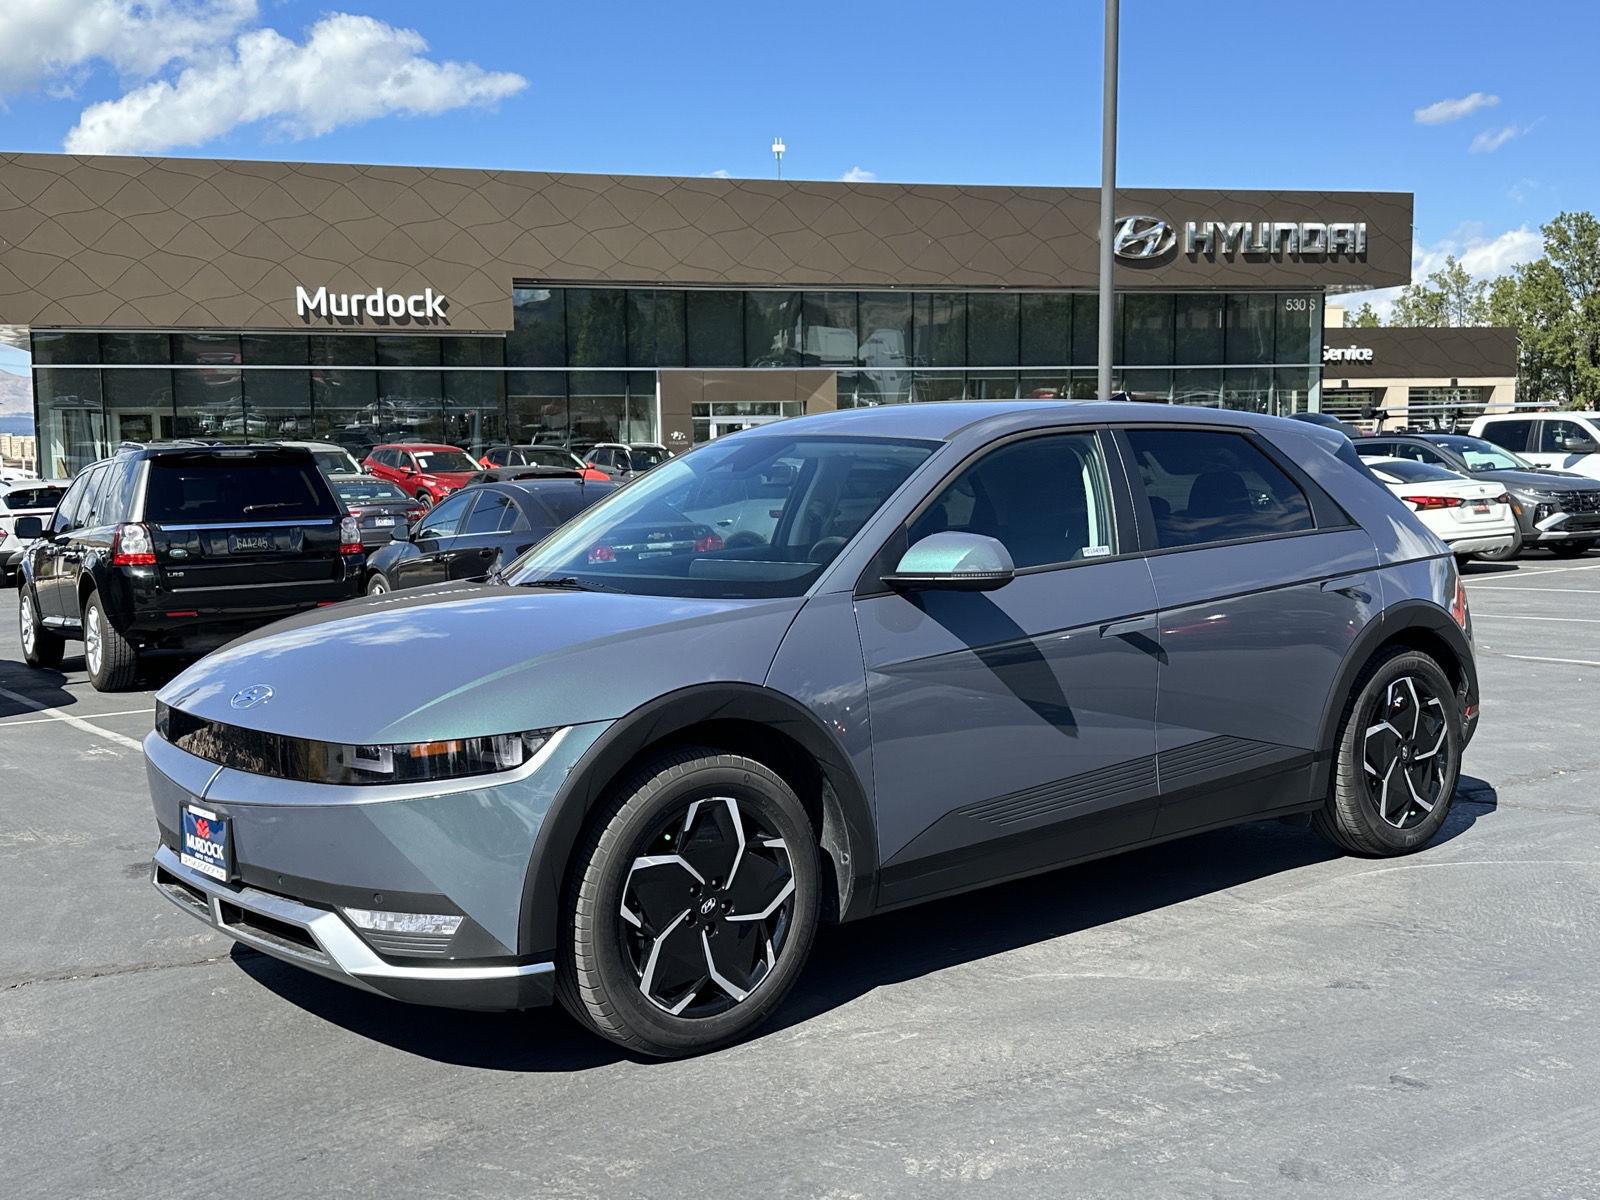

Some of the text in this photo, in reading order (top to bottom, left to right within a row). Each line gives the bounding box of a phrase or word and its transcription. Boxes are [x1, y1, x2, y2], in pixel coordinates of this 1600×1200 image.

[1184, 221, 1367, 254] HYUNDAI
[296, 286, 447, 318] Murdock
[1285, 298, 1316, 311] 530 S
[1323, 345, 1373, 361] Service
[186, 833, 224, 860] MURDOCK
